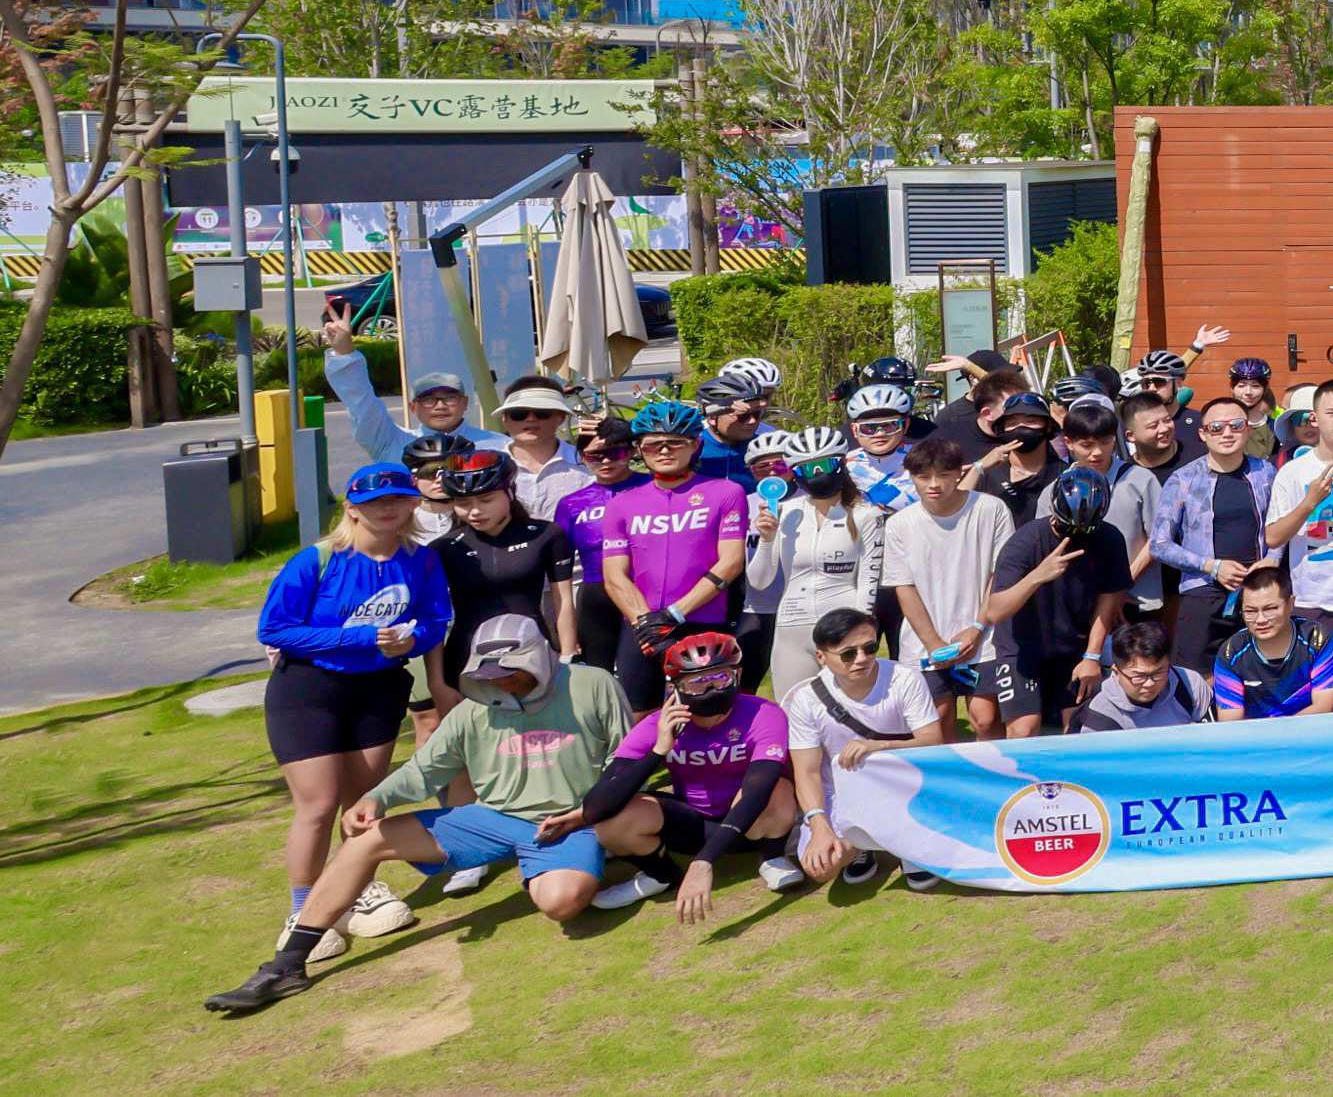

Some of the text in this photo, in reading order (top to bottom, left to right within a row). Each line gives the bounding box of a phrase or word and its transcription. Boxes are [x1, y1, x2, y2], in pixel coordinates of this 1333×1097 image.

[270, 96, 338, 109] JAOZI
[630, 507, 710, 535] NSVE
[667, 743, 748, 767] NSVE
[1013, 813, 1092, 835] AMSTEL
[1120, 789, 1288, 836] EXTRA
[1034, 837, 1075, 852] BEER
[1125, 826, 1285, 849] EUROPEAN QUALITY
